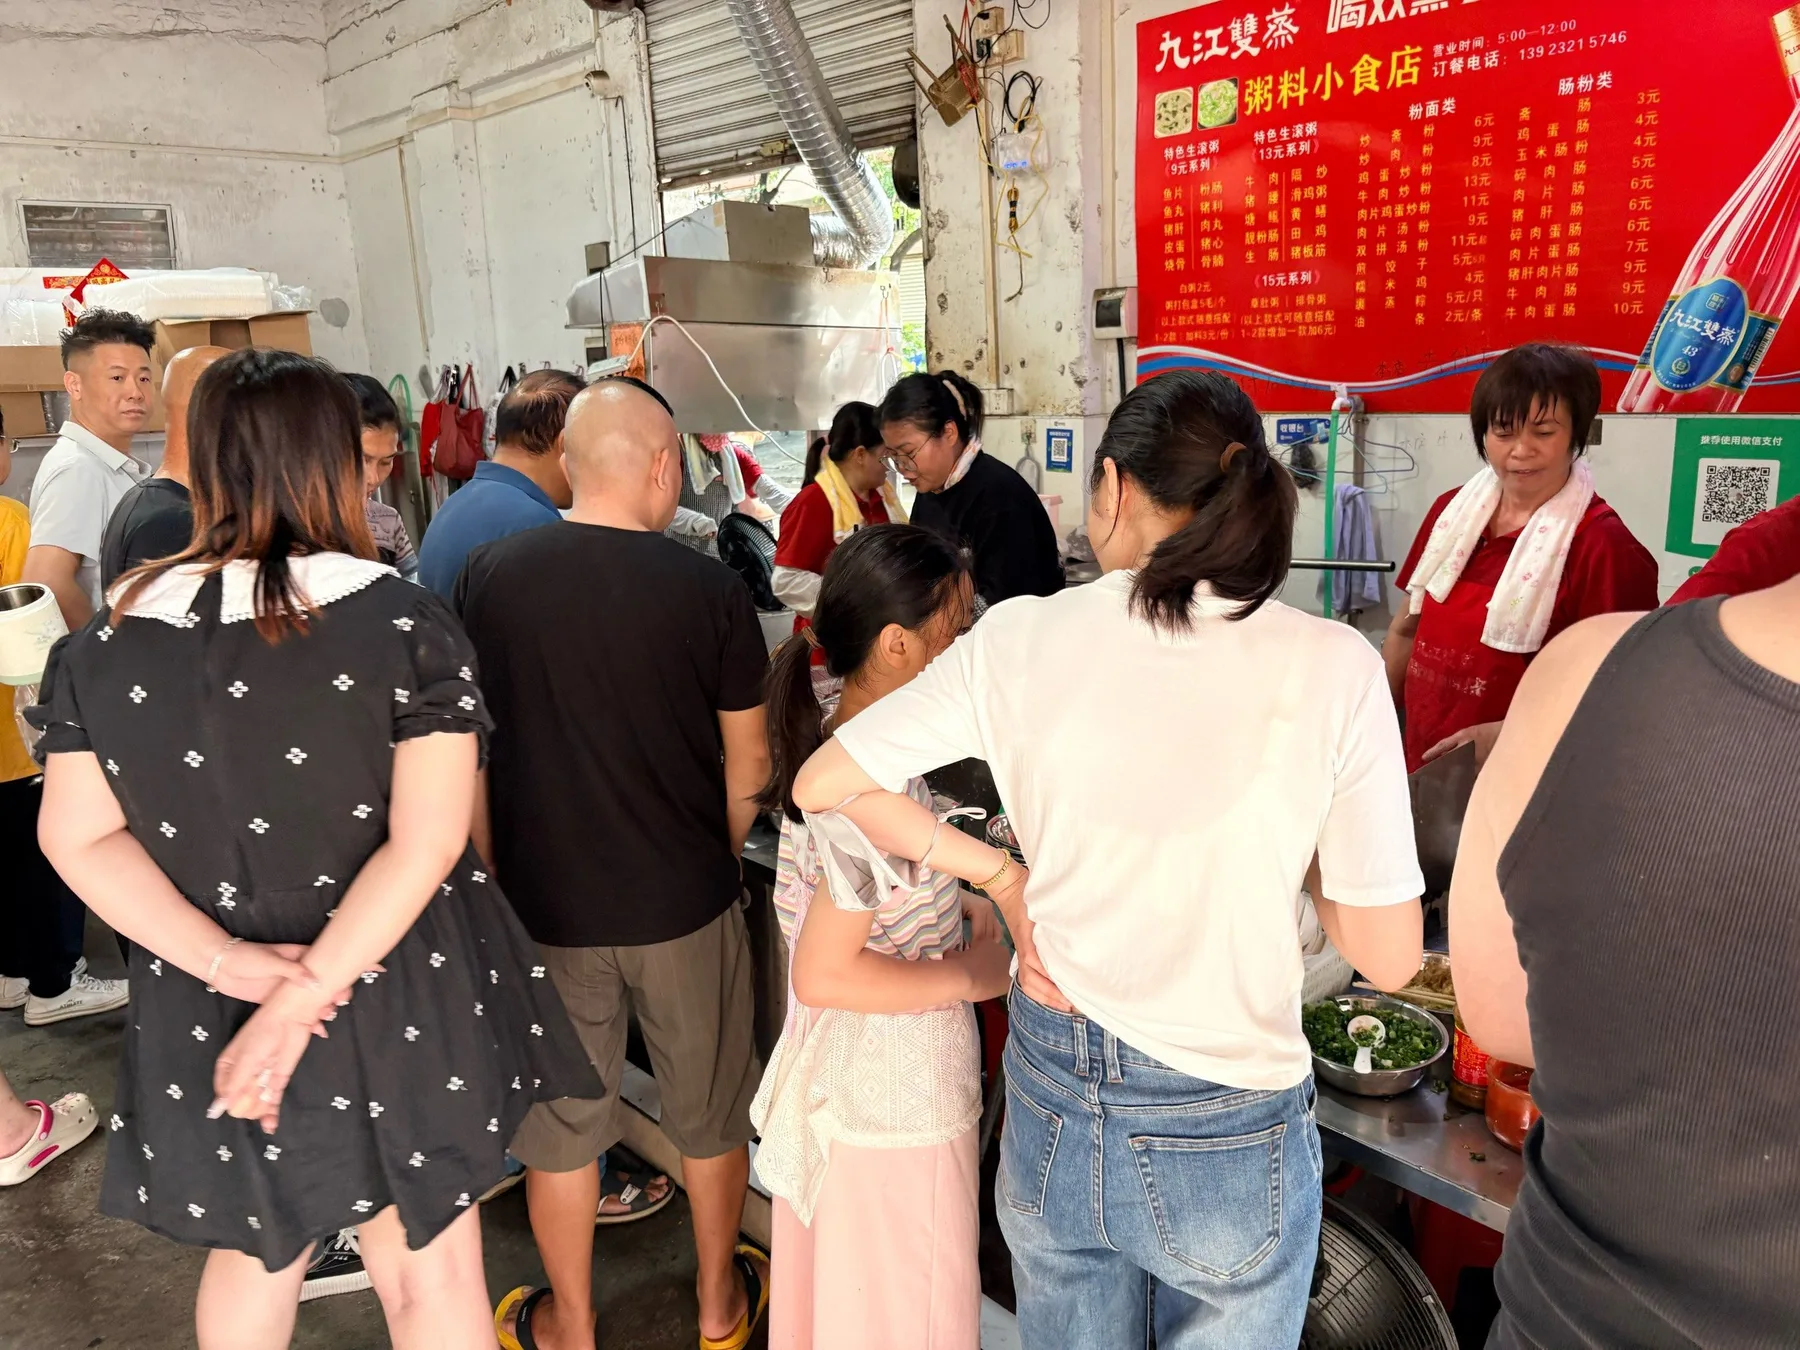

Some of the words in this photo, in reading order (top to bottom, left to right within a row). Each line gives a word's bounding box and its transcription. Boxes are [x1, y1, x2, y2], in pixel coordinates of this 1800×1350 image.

[1155, 3, 1299, 72] 九江雙蒸
[1244, 45, 1423, 116] 粥料小食店
[1558, 70, 1613, 96] 肠粉类
[1637, 88, 1661, 105] 3元
[1408, 97, 1456, 121] 粉面类
[1474, 113, 1495, 127] 6元
[1635, 110, 1659, 126] 4元
[1253, 121, 1318, 145] 特色生滚粥
[1473, 133, 1493, 147] 9元
[1633, 132, 1657, 147] 4元
[1164, 139, 1220, 161] 特色生滚粥
[1472, 153, 1492, 167] 8元
[1631, 153, 1656, 169] 5元
[1464, 173, 1491, 187] 13元
[1630, 175, 1654, 190] 6元
[1357, 201, 1430, 221] 肉片鸡蛋炒粉
[1463, 193, 1490, 207] 11元
[1629, 196, 1652, 211] 6元
[1468, 212, 1488, 226] 9元
[1627, 217, 1651, 232] 6元
[1626, 238, 1649, 253] 7元
[1465, 270, 1485, 284] 4元
[1508, 262, 1579, 281] 猪肝肉片肠
[1624, 259, 1647, 274] 9元
[1622, 280, 1645, 295] 9元
[1446, 289, 1483, 304] 5元/只
[1613, 300, 1644, 315] 10元
[1445, 308, 1483, 323] 2元/条
[1700, 435, 1783, 447] 推荐使用微信支付
